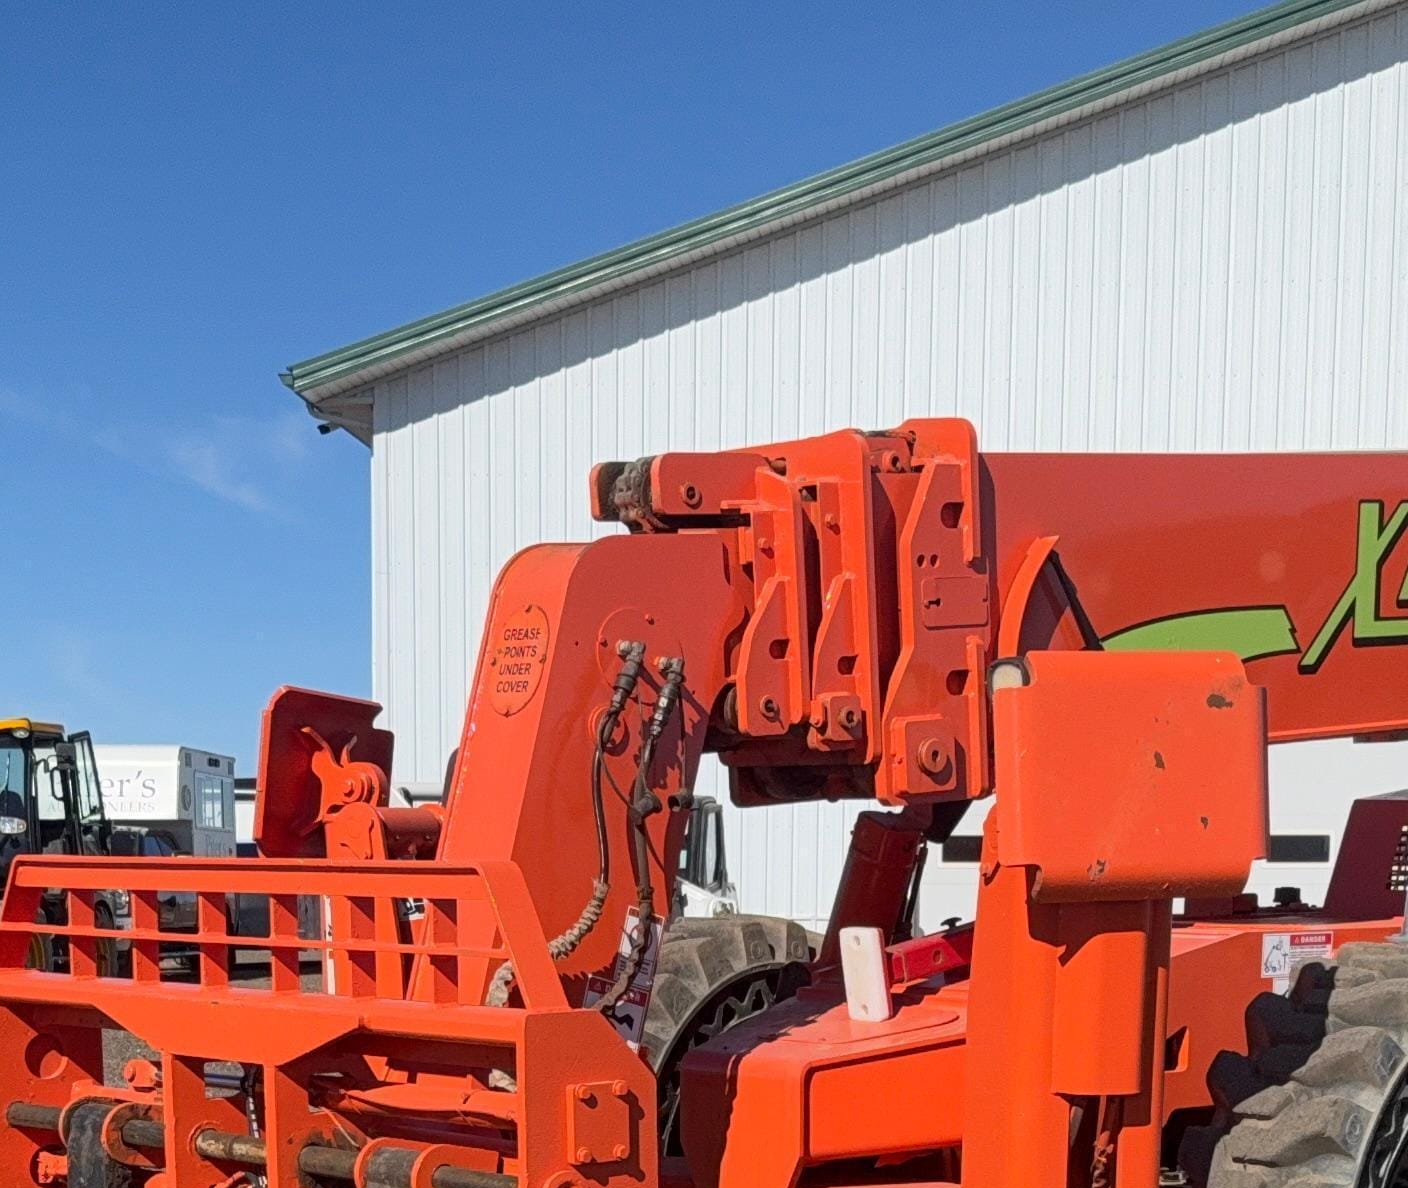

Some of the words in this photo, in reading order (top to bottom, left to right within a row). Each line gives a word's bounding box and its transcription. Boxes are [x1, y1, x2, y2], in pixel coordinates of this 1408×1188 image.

[503, 645, 538, 659] POINTS
[498, 662, 532, 676] UNDER
[496, 680, 529, 693] COVER
[1300, 935, 1326, 943] DANGER
